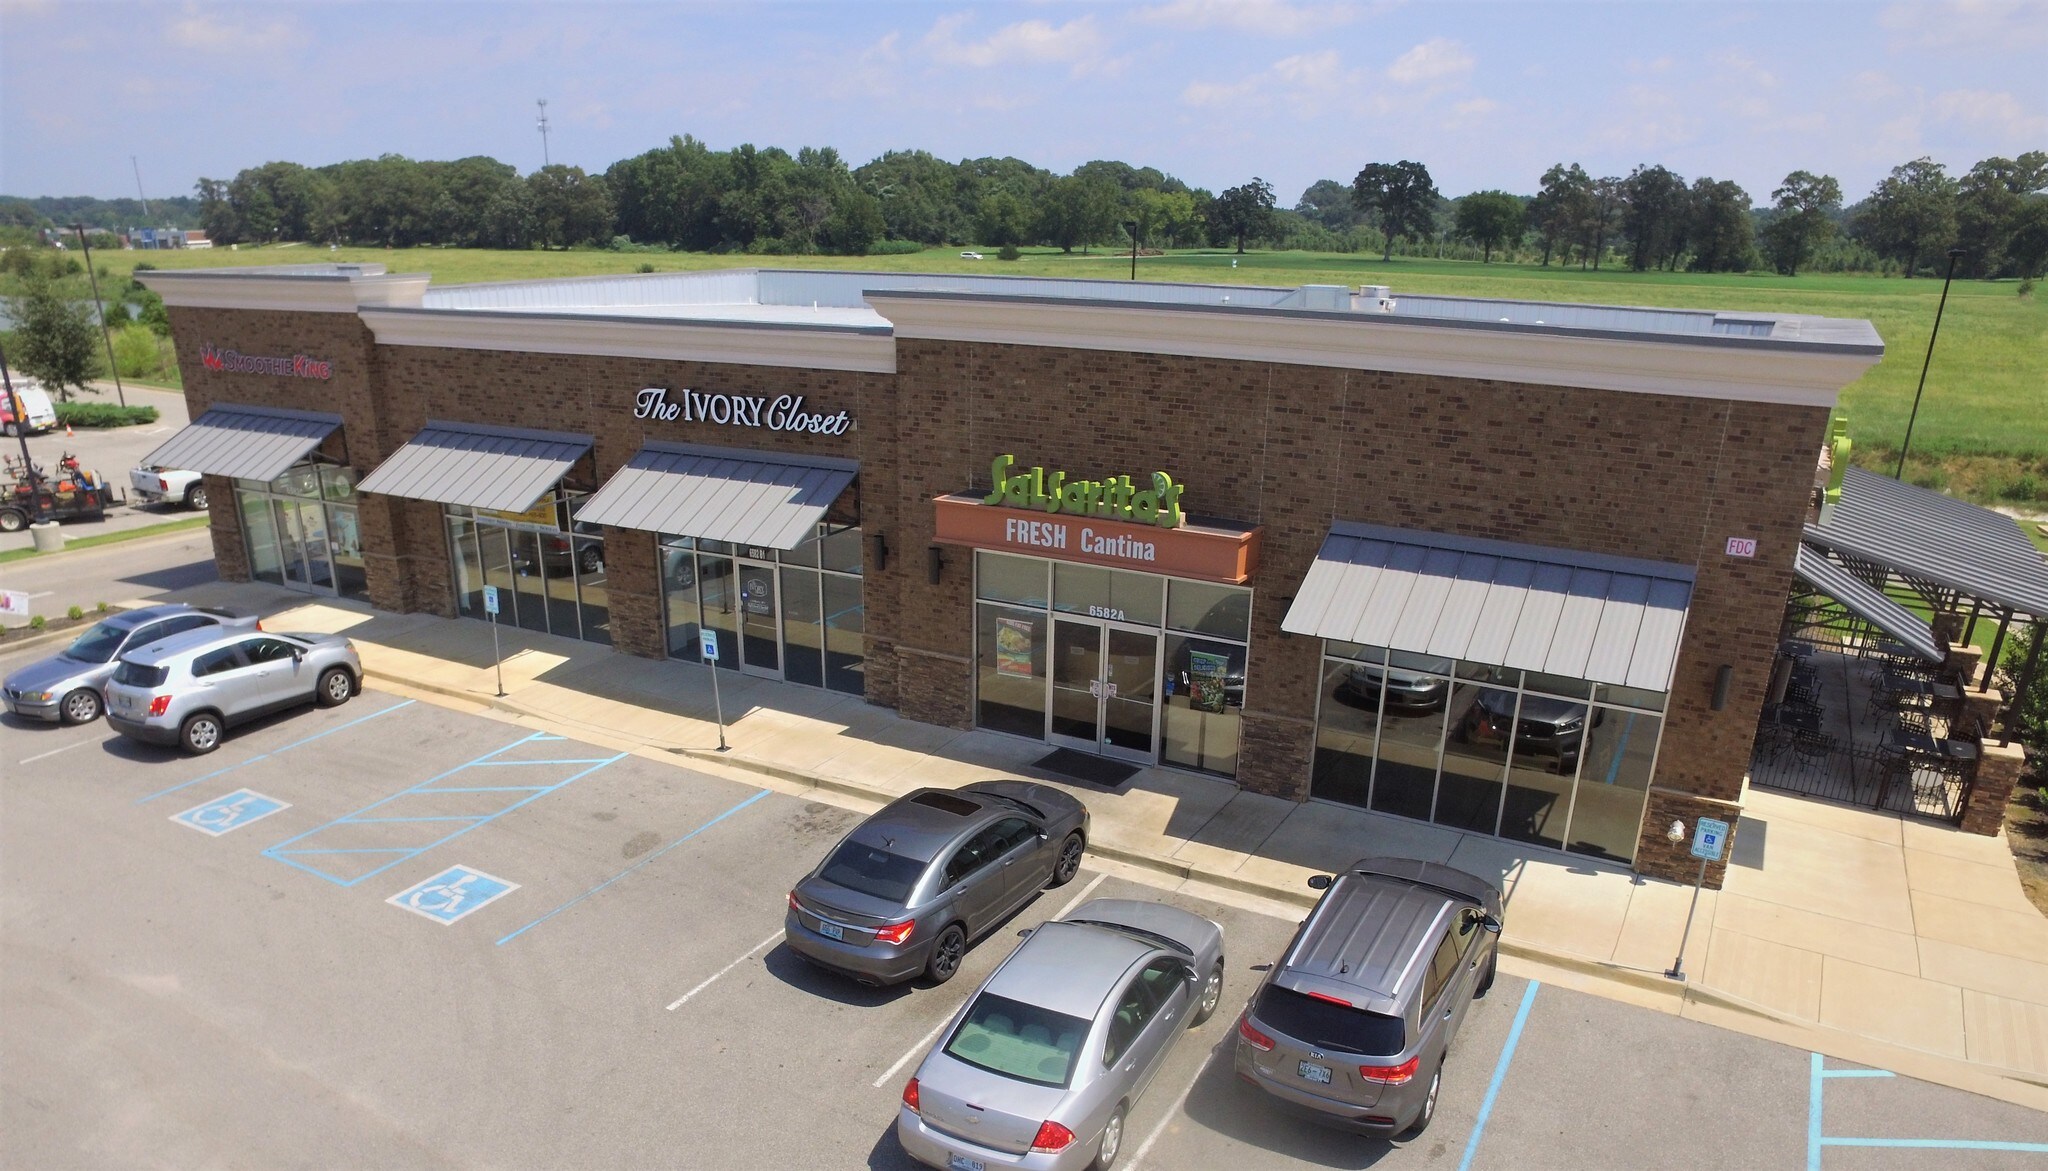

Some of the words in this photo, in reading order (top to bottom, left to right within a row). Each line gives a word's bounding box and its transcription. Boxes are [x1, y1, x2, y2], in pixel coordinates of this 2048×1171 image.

[224, 350, 292, 377] SMOOTHIE
[634, 388, 680, 421] The
[683, 389, 765, 427] IVORY
[767, 395, 849, 435] Closet
[984, 455, 1184, 528] Salsarita's
[1006, 518, 1067, 549] FRESH
[1081, 528, 1155, 561] Cantina
[1729, 540, 1753, 555] FDC
[1089, 605, 1125, 621] 6582A
[1700, 821, 1726, 831] RESERVED
[1700, 828, 1723, 836] PARKING
